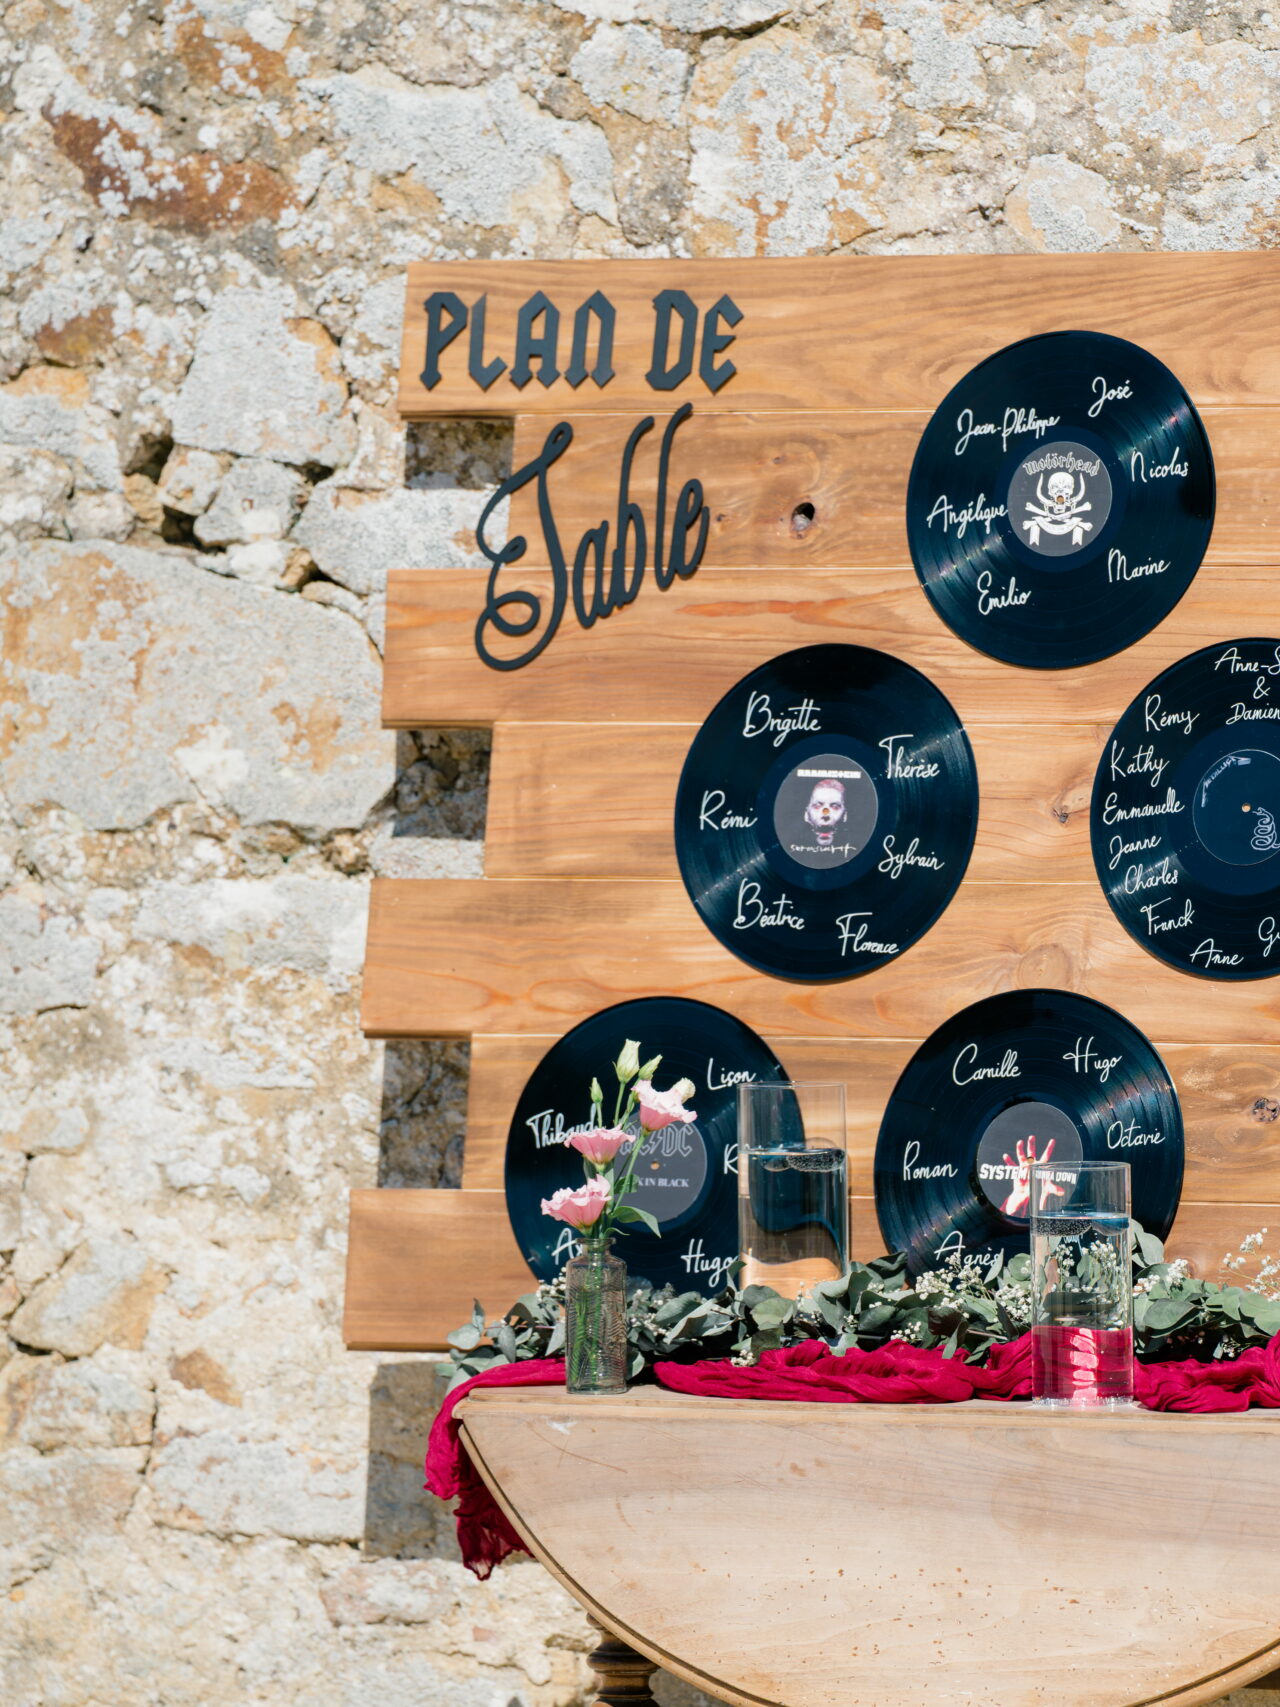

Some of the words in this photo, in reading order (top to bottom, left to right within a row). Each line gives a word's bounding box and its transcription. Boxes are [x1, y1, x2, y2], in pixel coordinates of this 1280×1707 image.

[419, 290, 616, 392] PLAN
[645, 289, 744, 395] DE
[1088, 376, 1133, 417] José
[955, 407, 1060, 455] Jean-Philippe
[1130, 447, 1189, 483] Nicolas
[927, 493, 1008, 538] Angélique
[475, 402, 709, 672] Table
[1108, 548, 1171, 582] Marine
[977, 571, 1031, 615] Emilio
[1252, 676, 1271, 699] &
[742, 691, 822, 747] Brigitte
[1144, 694, 1201, 734] Rémy
[878, 734, 941, 779] Thérèse
[1110, 740, 1170, 787] Kathy
[699, 789, 758, 830] Rémi
[1102, 787, 1185, 825] Emmanuelle
[878, 835, 944, 879] Sylvain
[1109, 834, 1161, 870] Jeanne
[1124, 857, 1179, 894] Charles
[733, 878, 805, 929] Béatrice
[1140, 897, 1195, 935] Franck
[836, 912, 899, 956] Florence
[1190, 938, 1244, 968] Anne
[707, 1057, 756, 1091] Lison
[952, 1043, 1021, 1086] Camille
[1062, 1036, 1122, 1083] Hugo
[1107, 1117, 1166, 1150] Octavie
[903, 1140, 958, 1181] Roman
[657, 1178, 689, 1188] BLACK
[681, 1238, 739, 1287] Hugo
